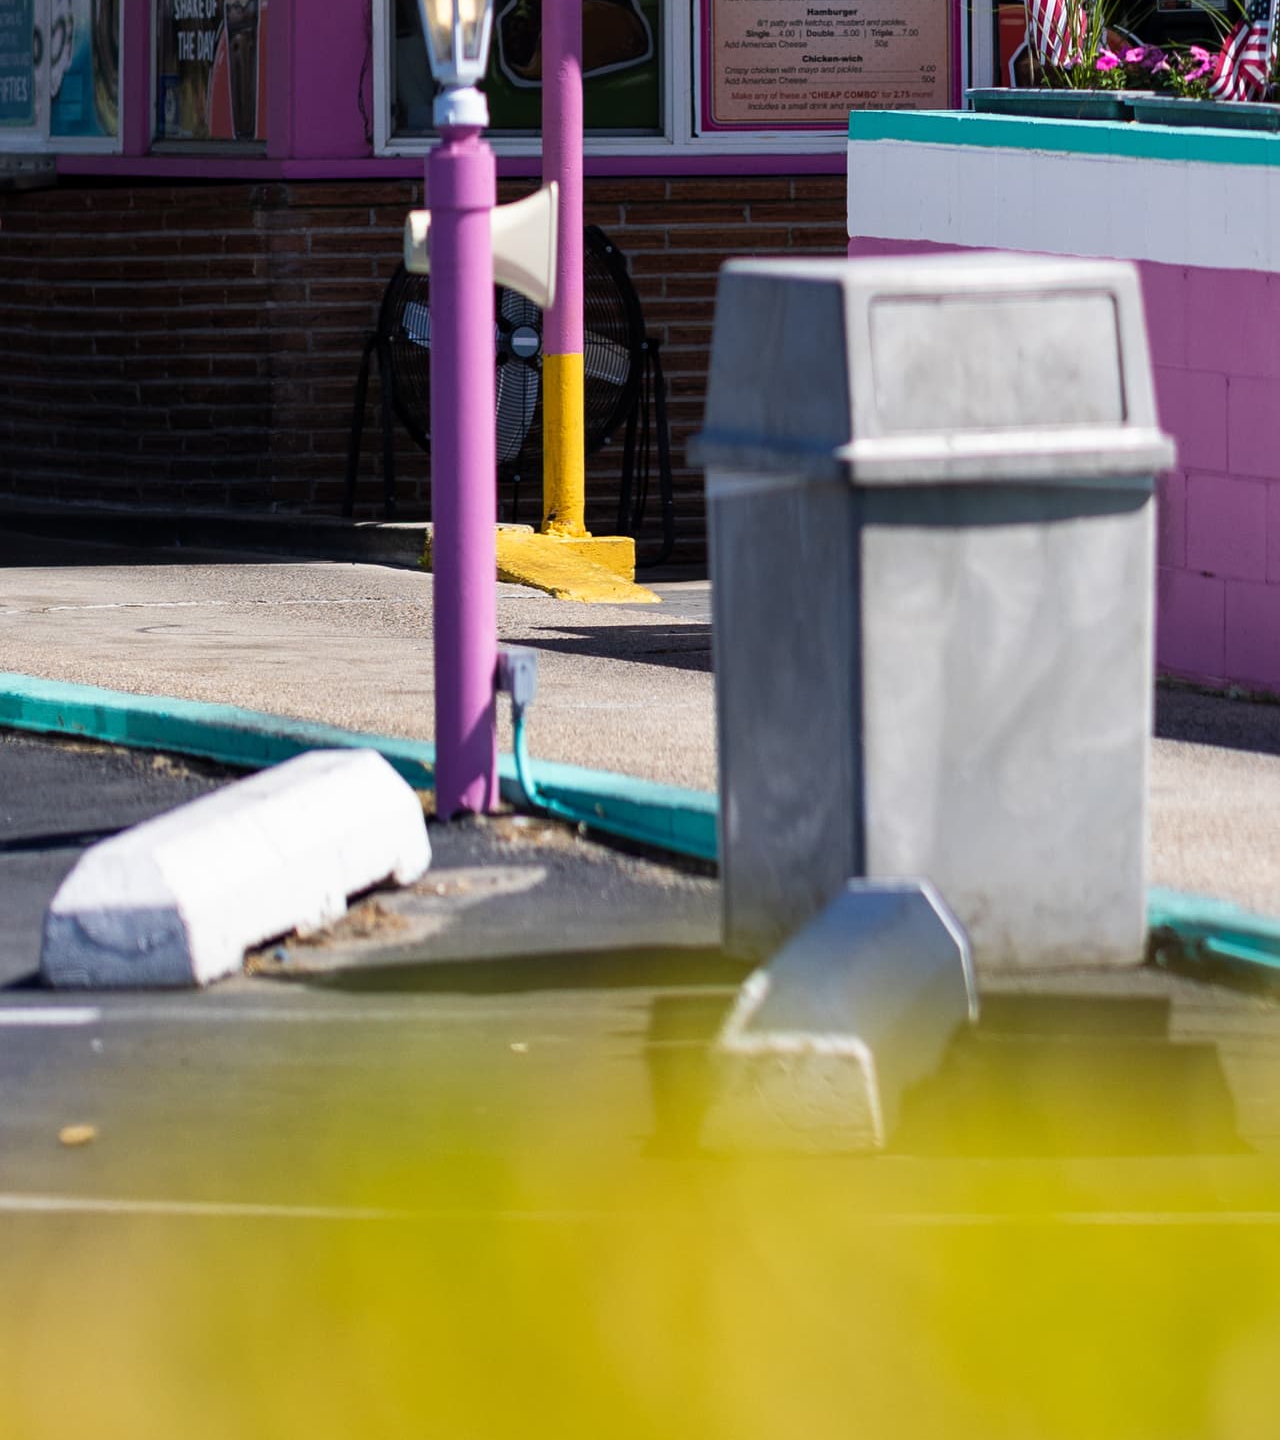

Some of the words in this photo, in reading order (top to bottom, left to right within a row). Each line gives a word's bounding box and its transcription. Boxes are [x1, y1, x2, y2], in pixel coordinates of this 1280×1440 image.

[807, 8, 858, 18] Hamburger
[746, 29, 770, 38] Single
[779, 29, 795, 38] 4.00
[806, 29, 835, 38] Double
[871, 29, 893, 38] Triple
[178, 30, 196, 60] THE
[197, 30, 216, 60] DAY
[724, 40, 739, 49] Add
[740, 40, 777, 49] American
[778, 40, 807, 49] Cheese
[802, 54, 863, 63] Chicken-wich
[724, 76, 739, 85] Add
[740, 76, 777, 85] American
[778, 76, 807, 85] Cheese
